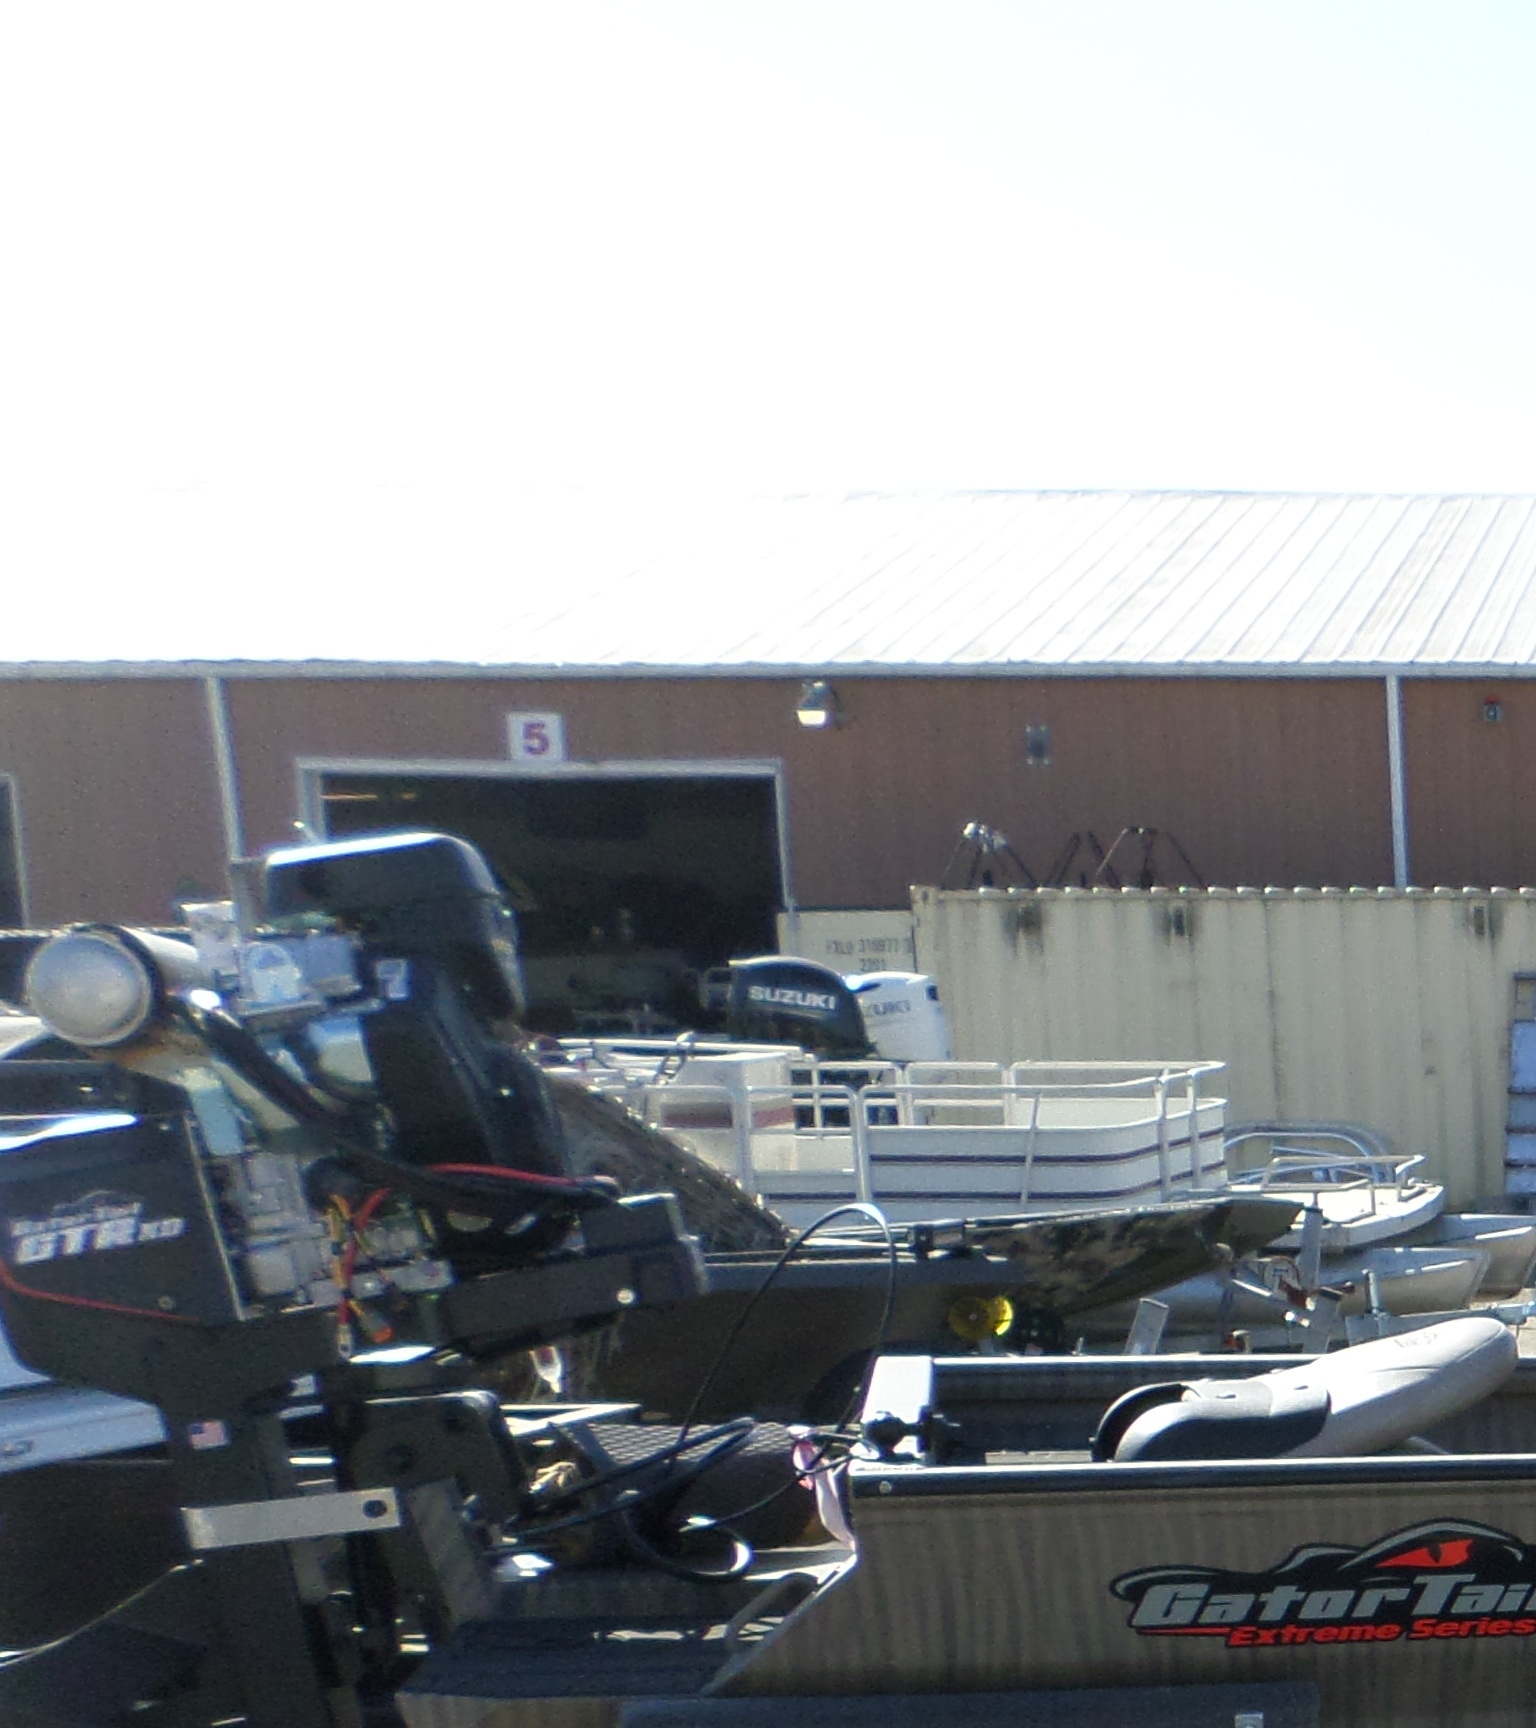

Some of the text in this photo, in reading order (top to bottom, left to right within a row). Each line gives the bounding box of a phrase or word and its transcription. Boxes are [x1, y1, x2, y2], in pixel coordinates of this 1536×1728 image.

[523, 722, 549, 756] 5
[749, 985, 837, 1010] SUZUKI
[1228, 1624, 1401, 1647] Extreme
